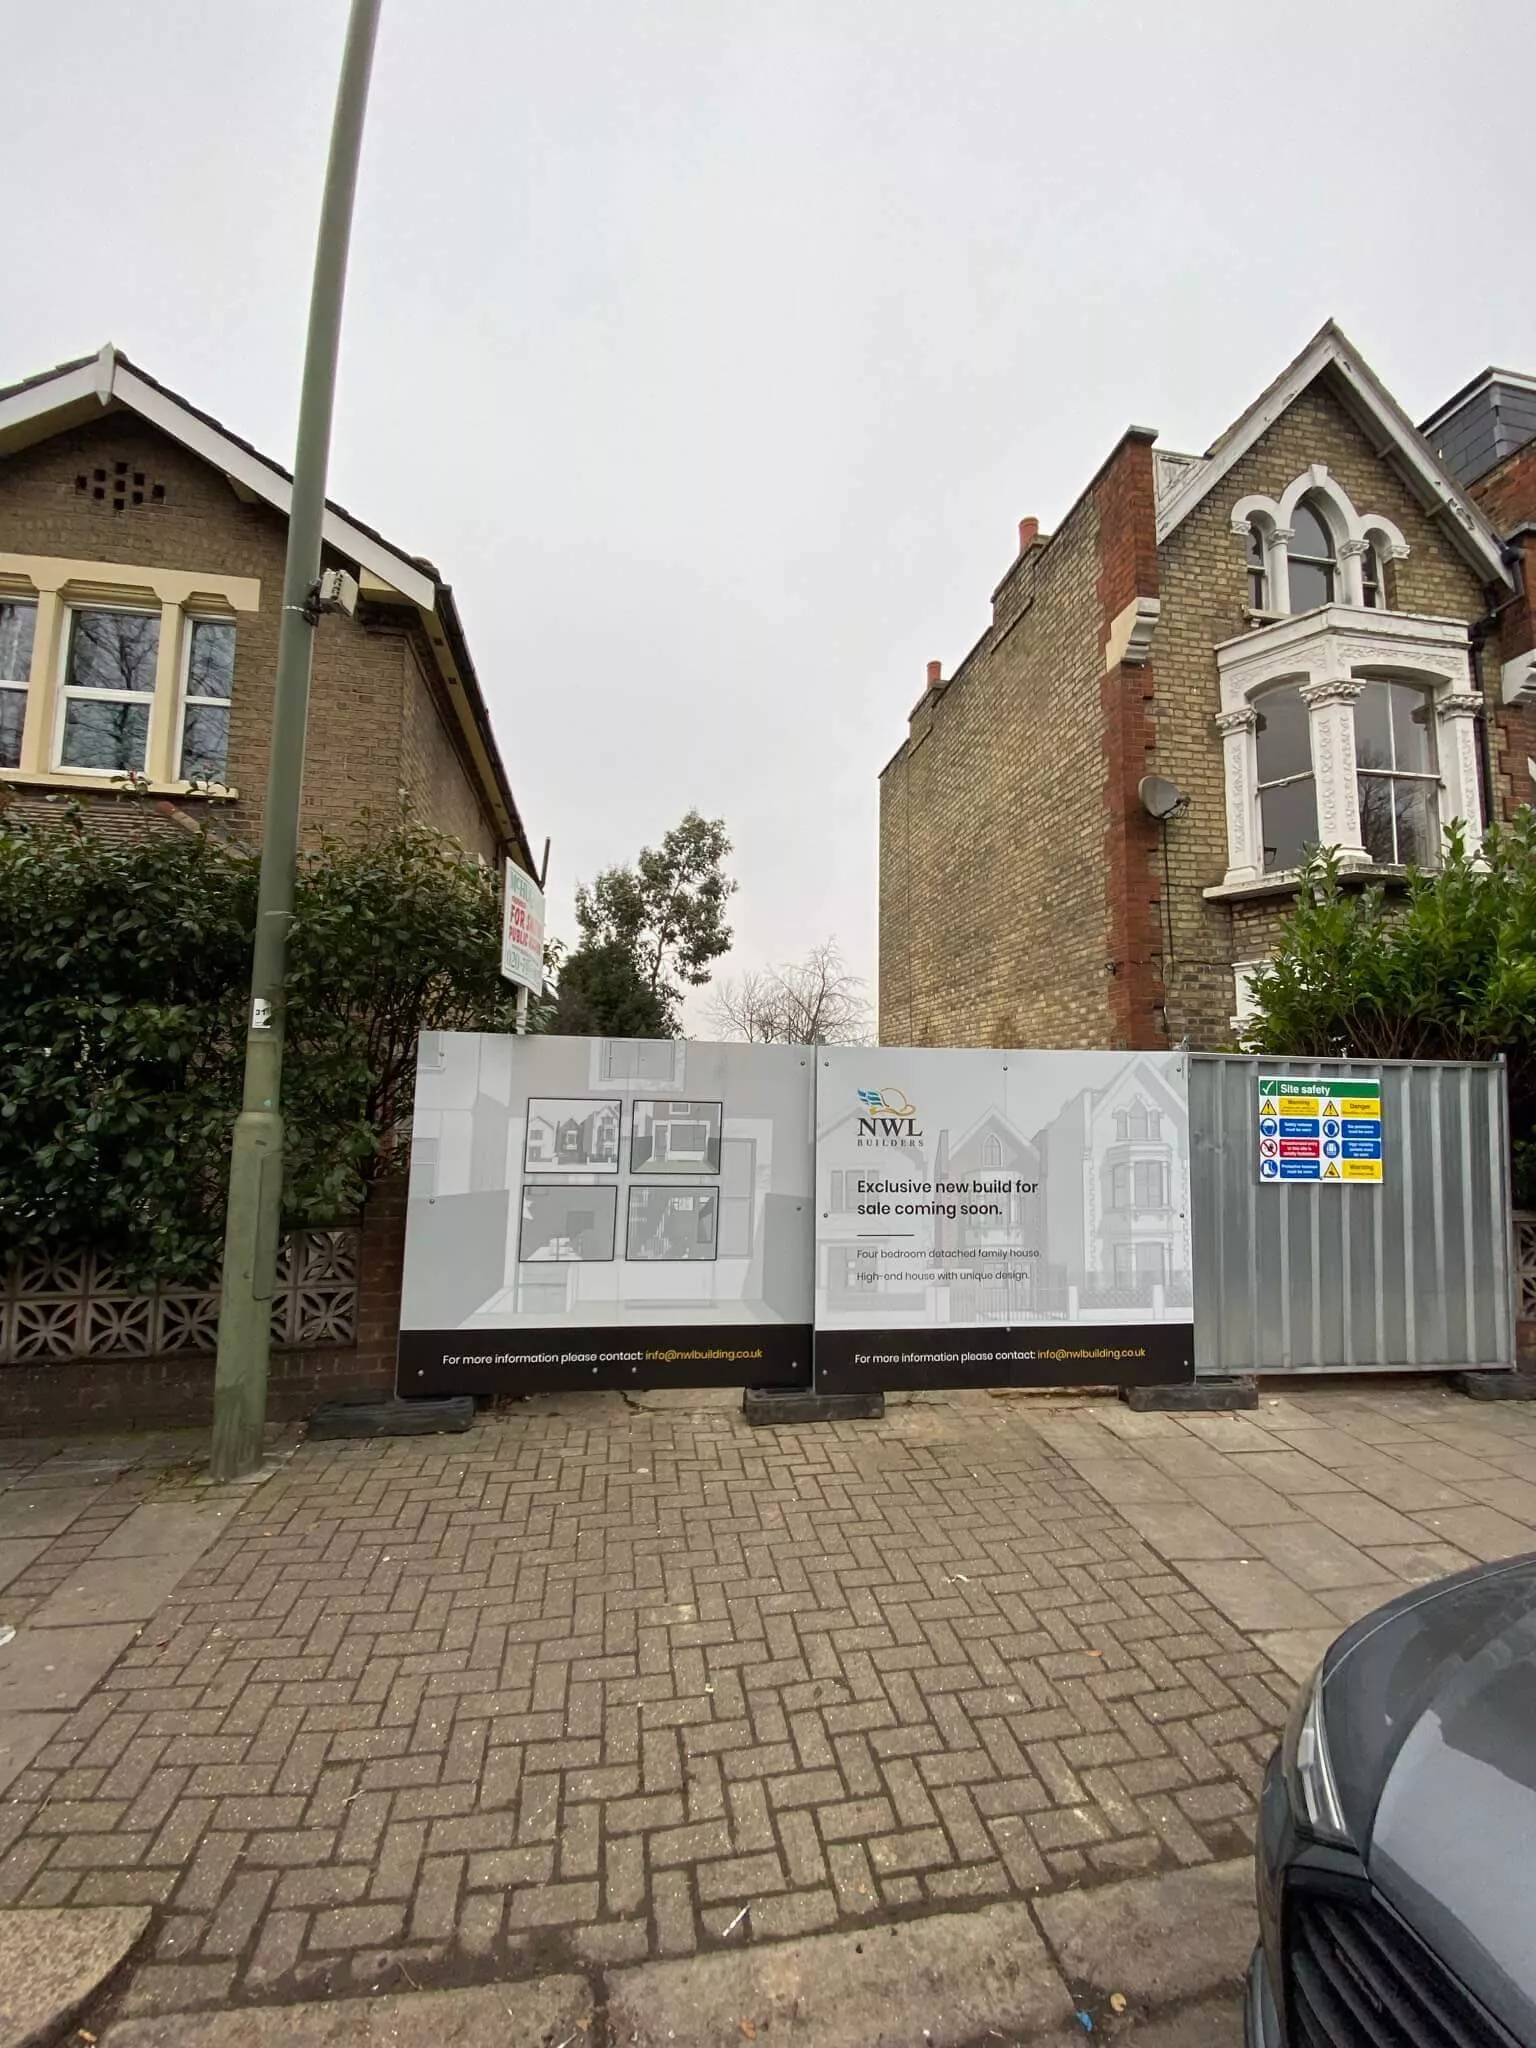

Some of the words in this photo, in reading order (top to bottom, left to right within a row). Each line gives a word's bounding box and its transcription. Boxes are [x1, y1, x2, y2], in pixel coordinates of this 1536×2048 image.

[1280, 1084, 1299, 1094] Site
[1301, 1085, 1331, 1096] safety
[857, 1118, 923, 1137] NWL
[857, 1139, 924, 1147] BUILDERS
[857, 1179, 932, 1194] Exclusive
[935, 1182, 969, 1194] new
[973, 1180, 1012, 1194] build
[1016, 1180, 1039, 1193] for
[857, 1202, 891, 1216] sale
[895, 1201, 956, 1219] coming
[960, 1204, 1003, 1216] soon.
[857, 1250, 878, 1259] Four
[881, 1249, 926, 1259] bedroom
[930, 1249, 976, 1258] detached
[978, 1249, 1008, 1261] family
[857, 1272, 903, 1284] High-end
[905, 1271, 935, 1281] house
[937, 1271, 958, 1281] with
[960, 1272, 993, 1284] unique
[995, 1271, 1030, 1282] design.
[443, 1354, 460, 1365] For
[462, 1356, 492, 1365] more
[494, 1353, 559, 1364] information
[561, 1351, 597, 1365] please
[645, 1348, 763, 1363] info@nwlbuilding.co.uk
[855, 1354, 871, 1364] For
[902, 1352, 959, 1363] information
[961, 1351, 993, 1364] please
[995, 1351, 1035, 1361] contact:
[1037, 1348, 1146, 1361] info@nwlbuilding.co.uk
